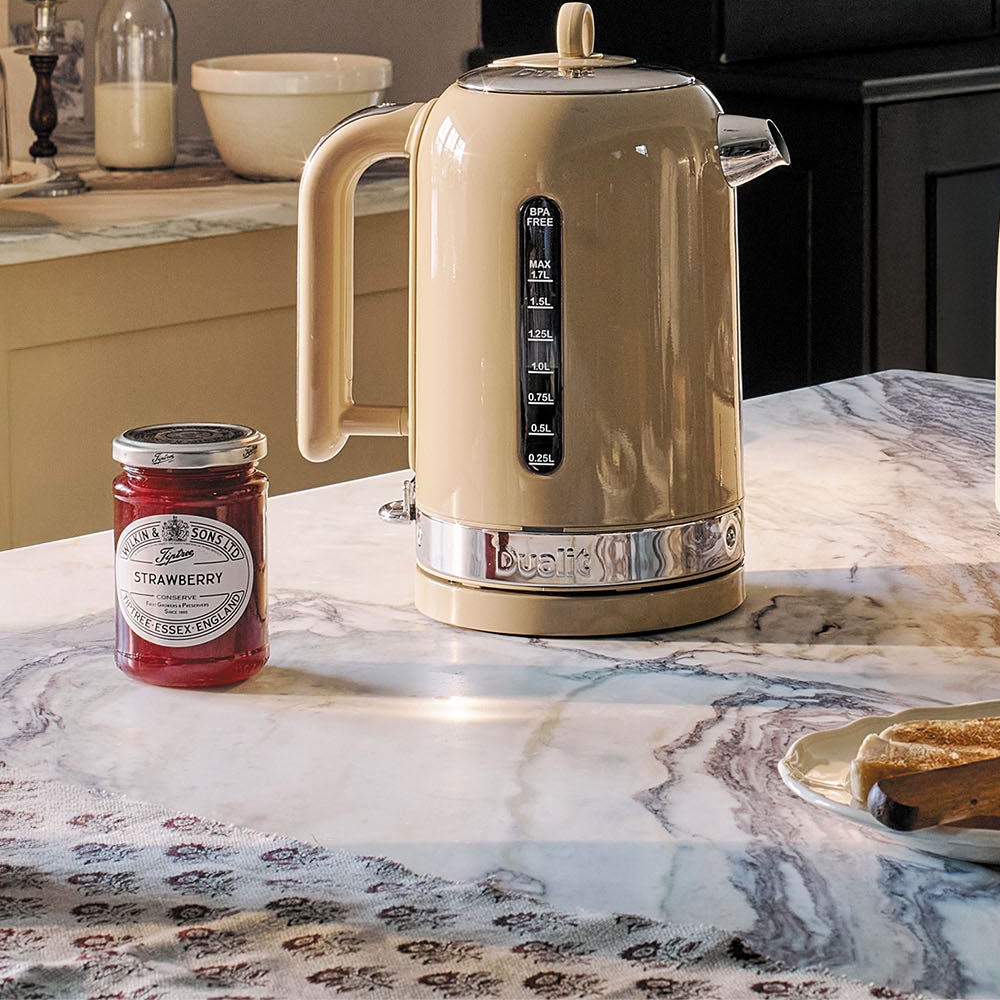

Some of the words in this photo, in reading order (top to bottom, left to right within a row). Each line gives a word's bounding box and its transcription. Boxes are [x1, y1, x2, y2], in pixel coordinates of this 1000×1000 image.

[529, 207, 551, 216] BPA
[526, 217, 554, 227] FREE
[529, 260, 551, 269] MAX
[531, 270, 550, 279] 1.7L
[530, 297, 551, 306] 1.5L
[528, 329, 553, 338] 1.25L
[531, 361, 551, 371] 1.0L
[528, 392, 554, 402] 0.75L
[530, 423, 551, 433] 0.5L
[528, 453, 555, 463] 0.25L
[123, 529, 149, 557] WILKIN
[151, 527, 159, 538] &
[190, 527, 223, 545] SONS
[223, 538, 241, 559] LTD
[155, 546, 194, 566] Tiptree
[495, 543, 591, 579] Dualit
[134, 571, 223, 586] STRAWBERRY
